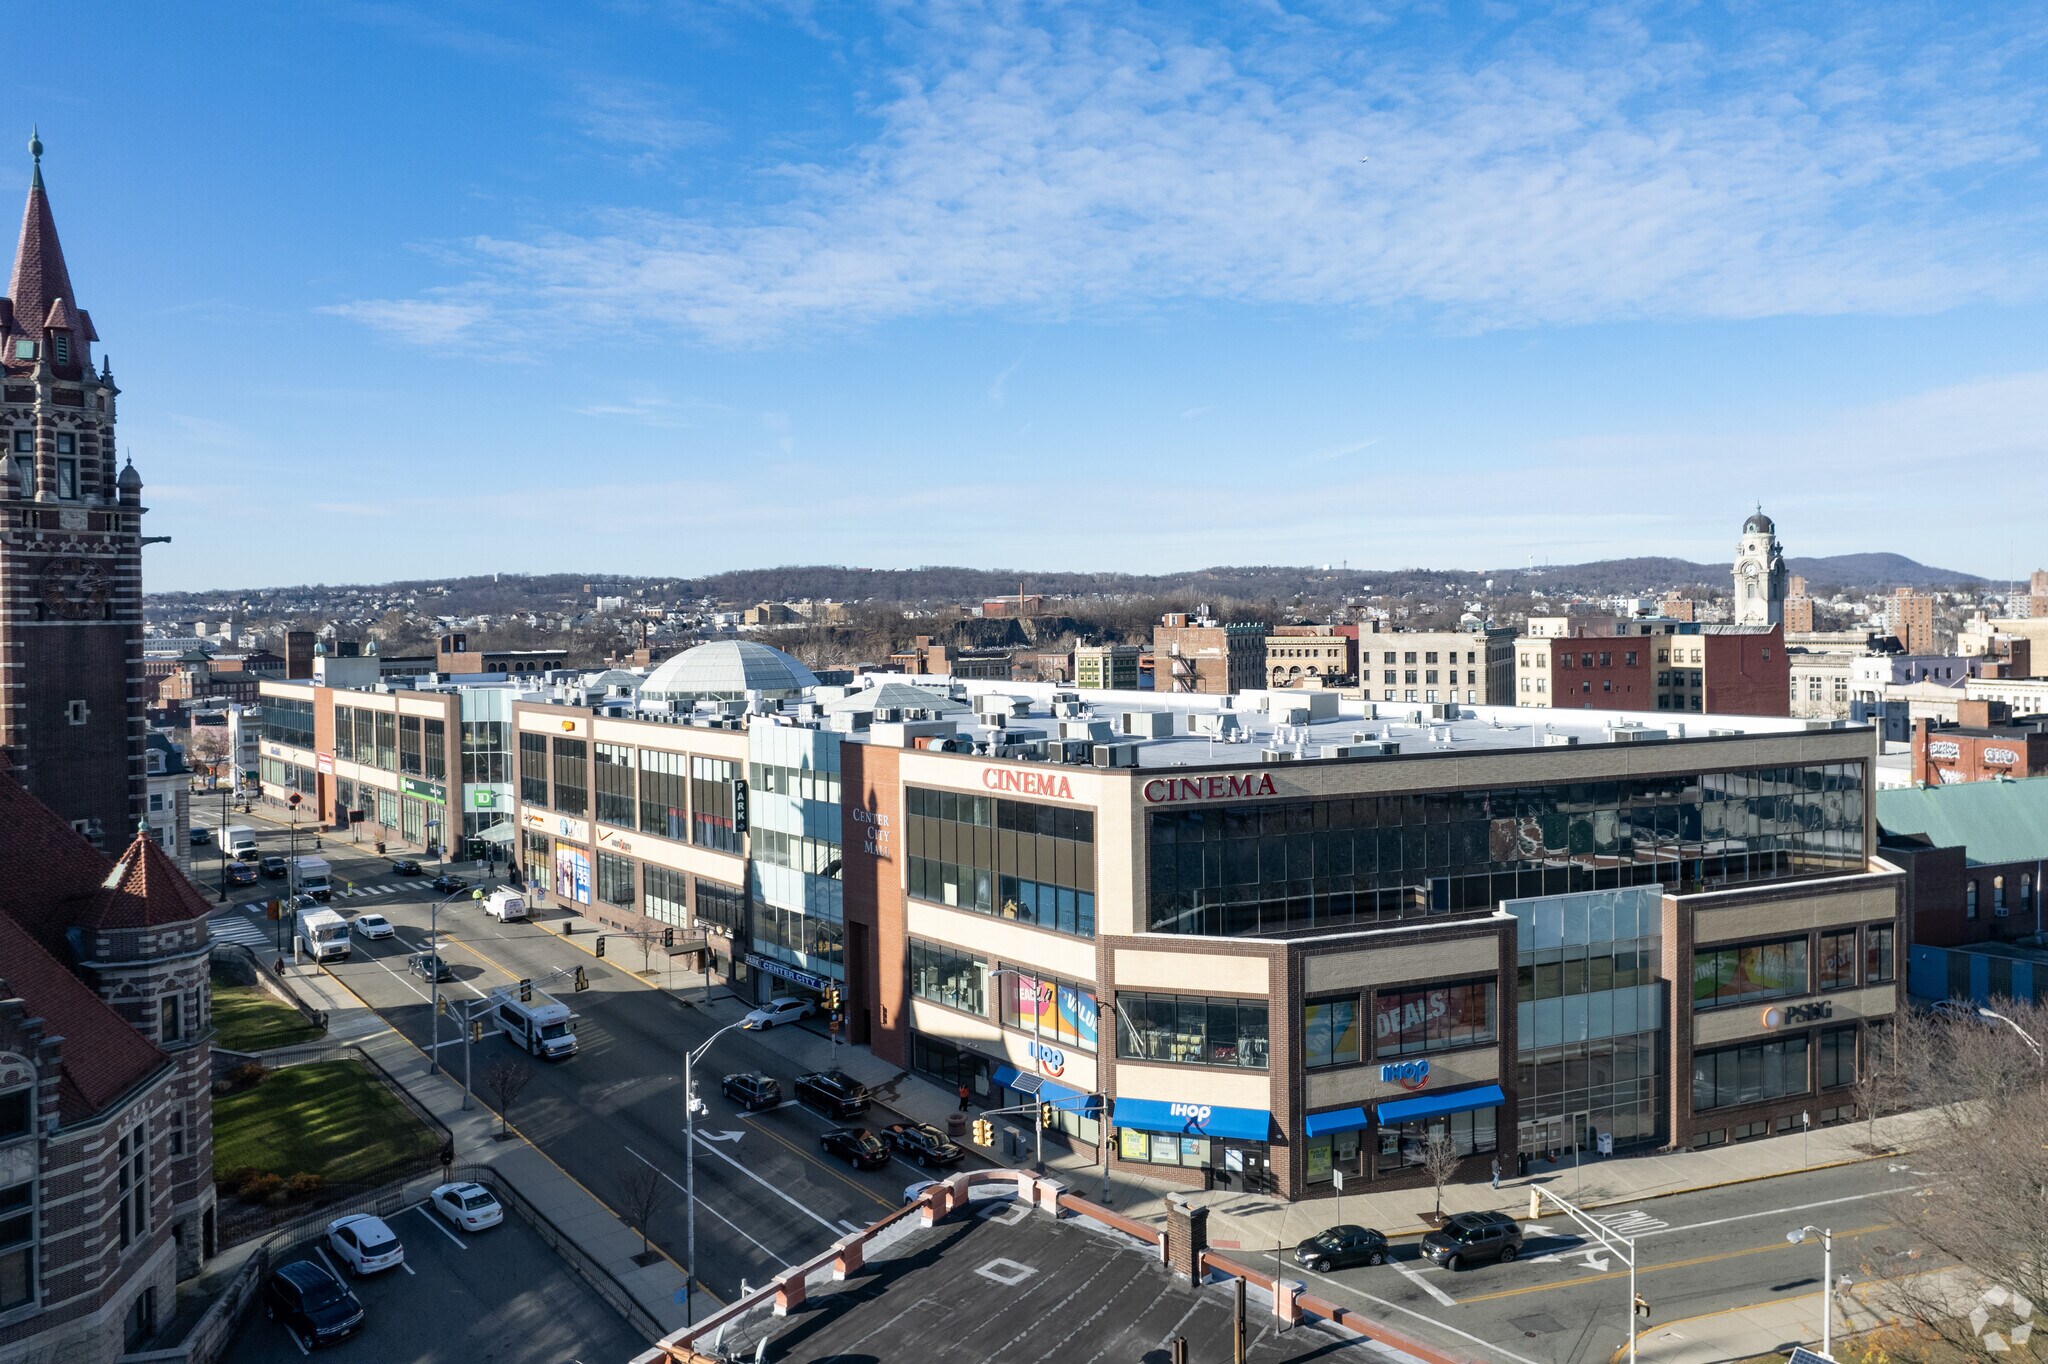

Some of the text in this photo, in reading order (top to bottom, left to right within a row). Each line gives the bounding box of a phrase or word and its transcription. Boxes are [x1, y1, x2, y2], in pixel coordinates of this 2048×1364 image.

[982, 767, 1075, 800] CINEMA
[1143, 772, 1278, 803] CINEMA
[475, 792, 490, 804] TD
[737, 782, 745, 821] PARK
[852, 808, 889, 827] CENTER
[867, 826, 890, 842] CITY
[864, 840, 889, 857] MALL
[763, 962, 816, 986] CENTER CITY
[1376, 992, 1447, 1039] DEALS
[1590, 1210, 1669, 1234] ONLY
